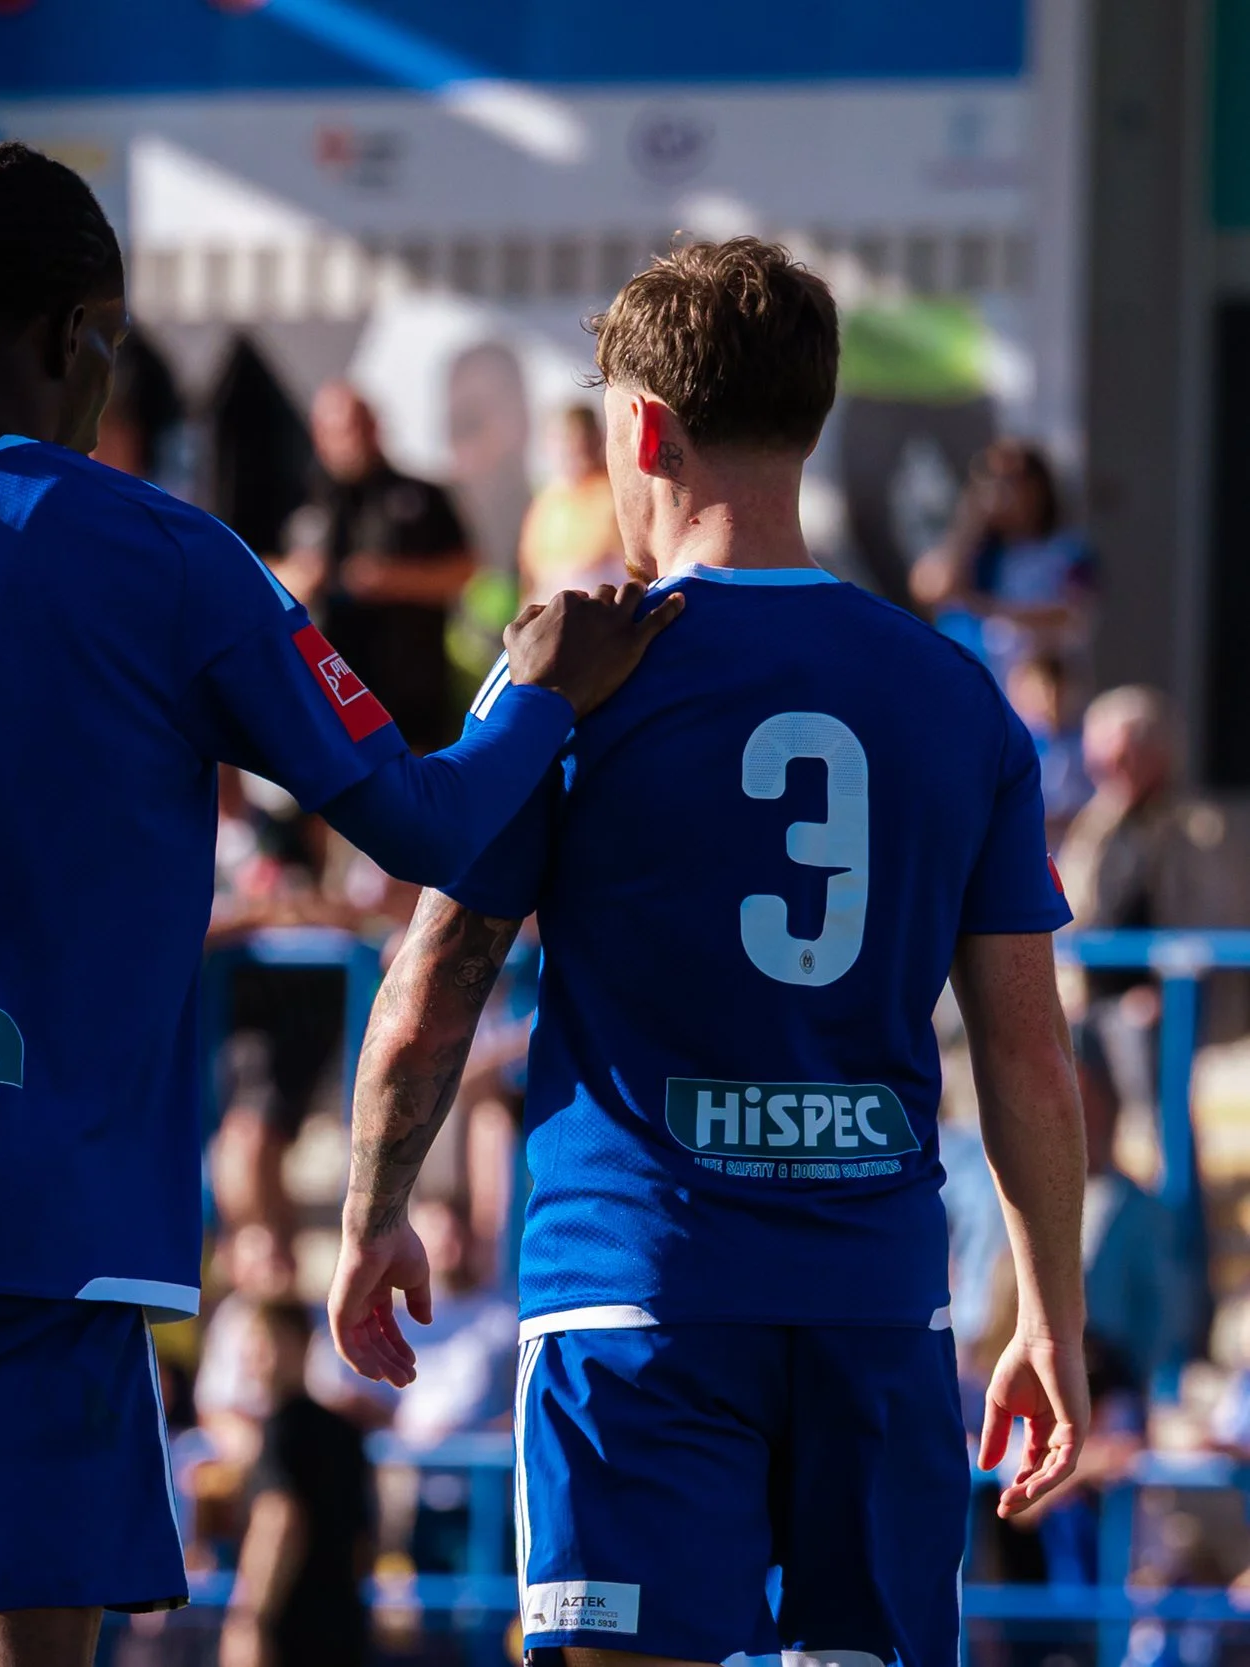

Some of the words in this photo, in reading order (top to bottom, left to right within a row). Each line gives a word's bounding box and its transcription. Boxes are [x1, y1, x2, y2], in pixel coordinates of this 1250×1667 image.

[740, 711, 869, 987] 3
[695, 1086, 888, 1149] HiSPEC
[725, 1160, 775, 1178] SAFETY
[841, 1159, 902, 1179] SOLUTIONS
[561, 1596, 607, 1608] AZTEK
